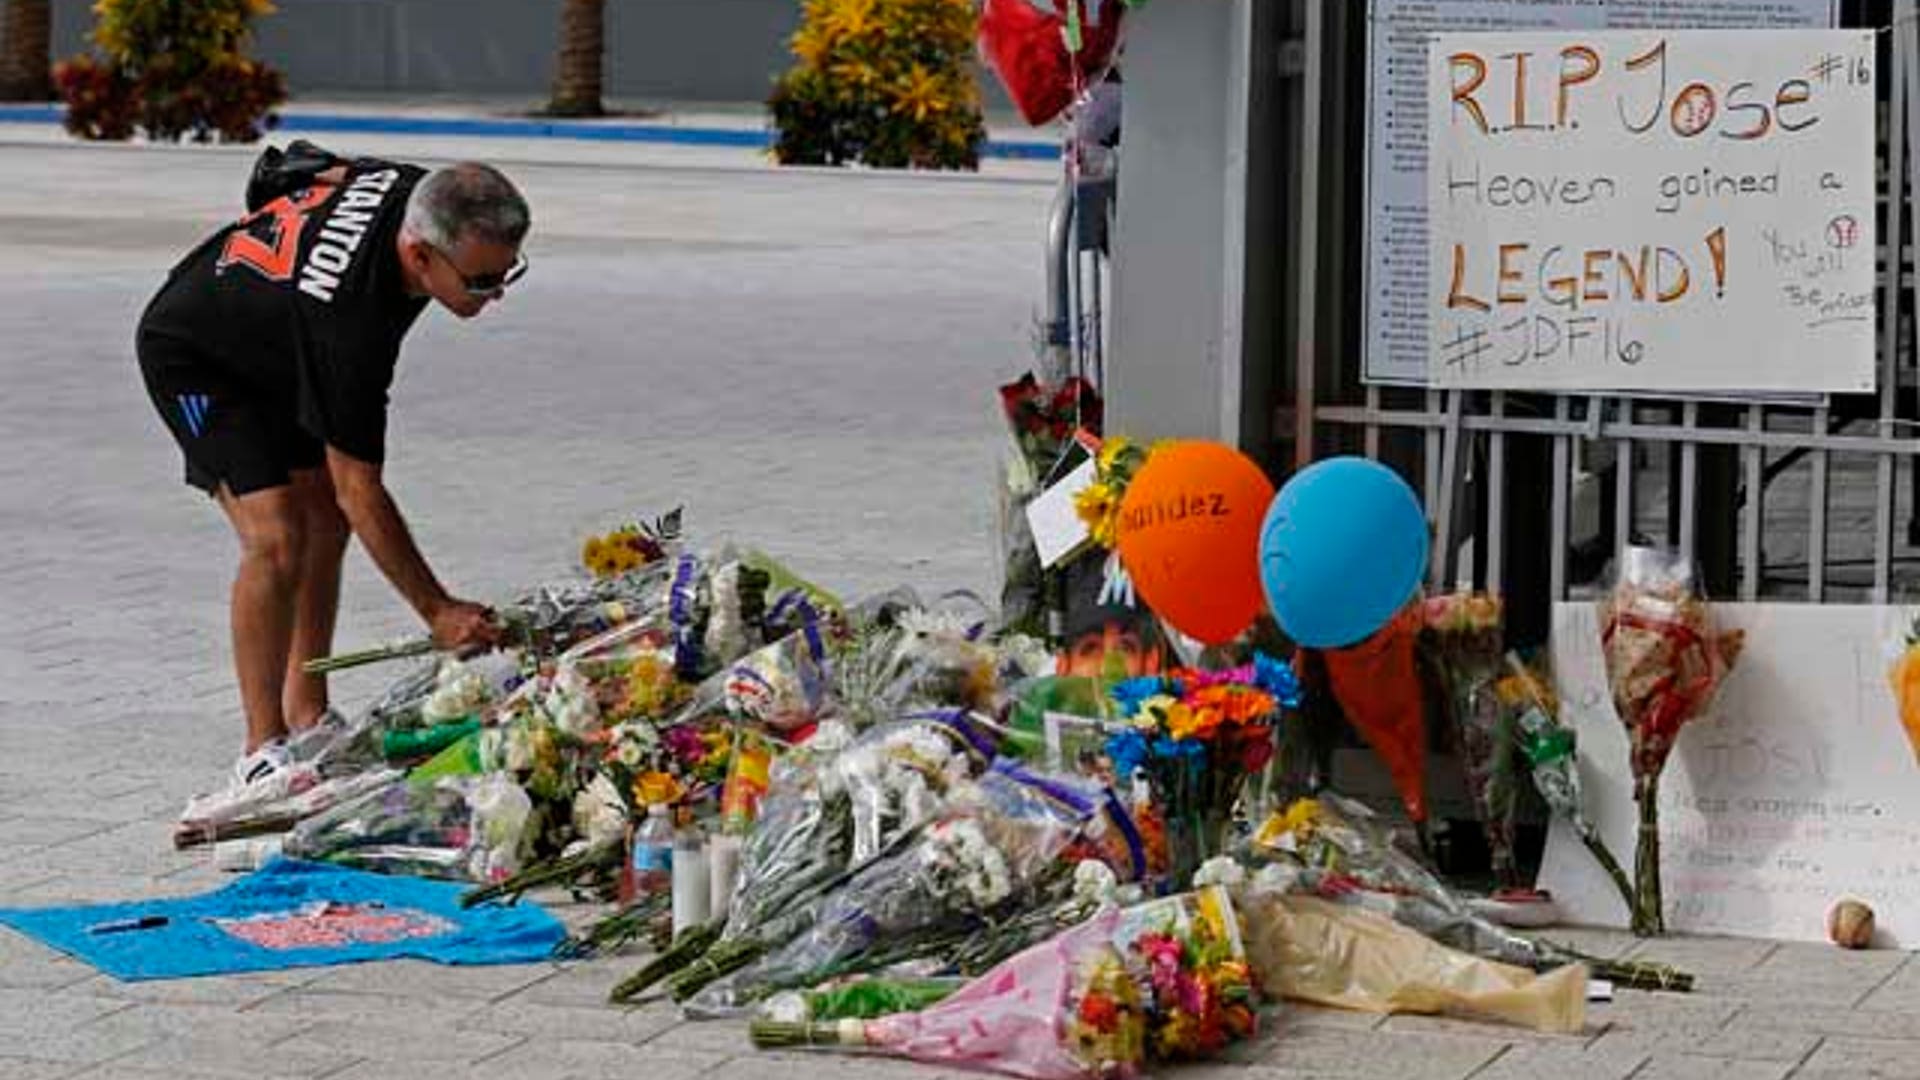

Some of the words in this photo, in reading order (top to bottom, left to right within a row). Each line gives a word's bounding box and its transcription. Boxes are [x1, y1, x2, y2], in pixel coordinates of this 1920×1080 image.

[1617, 40, 1820, 140] Jose
[1807, 52, 1871, 85] #16
[1448, 160, 1615, 206] Heaven
[1656, 164, 1780, 213] gained
[1819, 172, 1844, 190] a
[298, 168, 400, 302] STANTON
[1441, 315, 1645, 373] #JDF16
